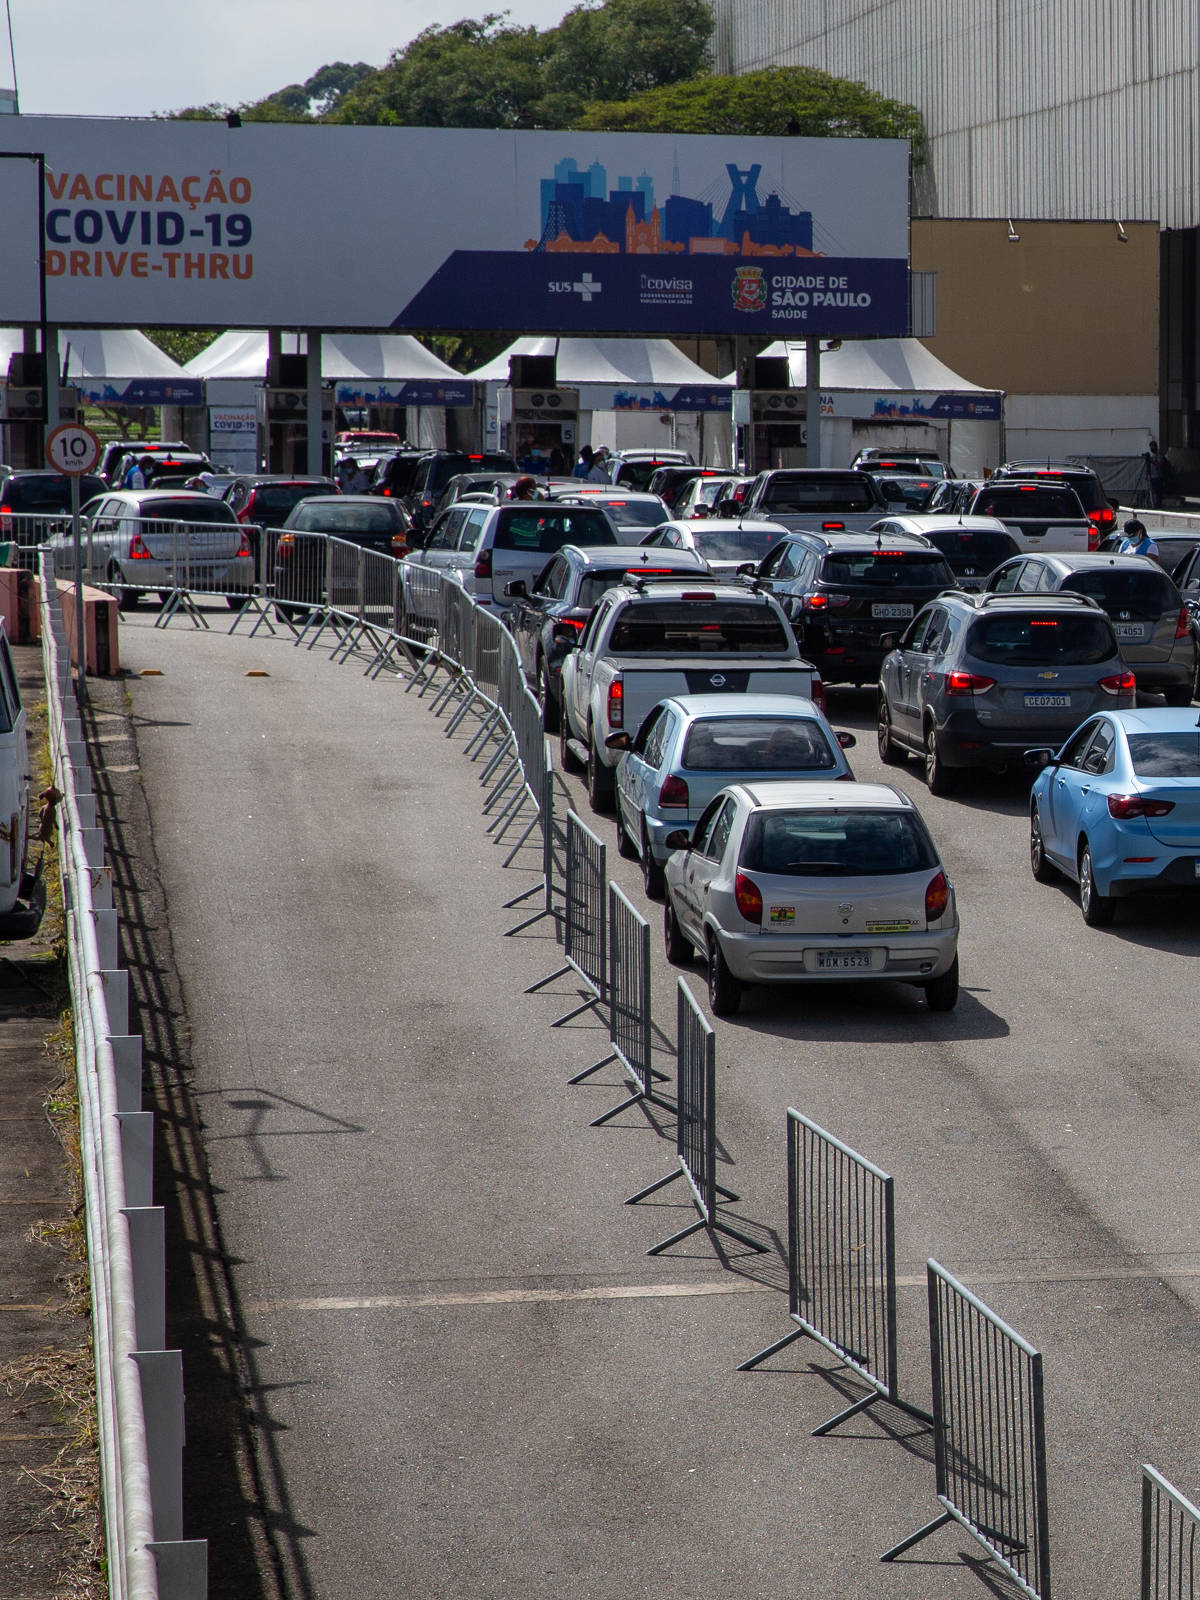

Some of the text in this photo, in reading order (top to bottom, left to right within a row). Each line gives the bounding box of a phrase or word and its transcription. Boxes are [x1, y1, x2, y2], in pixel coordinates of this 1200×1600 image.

[45, 169, 252, 210] VACINAÇÃO
[46, 208, 252, 247] COVID-19
[45, 250, 253, 280] DRIVE-THRU
[548, 282, 572, 292] SUS
[772, 276, 848, 288] CIDADE DE
[771, 288, 871, 307] SÃO PAULO
[771, 308, 808, 319] SAÚDE
[213, 421, 255, 429] COVID-19
[564, 430, 572, 440] 5
[60, 437, 87, 457] 10
